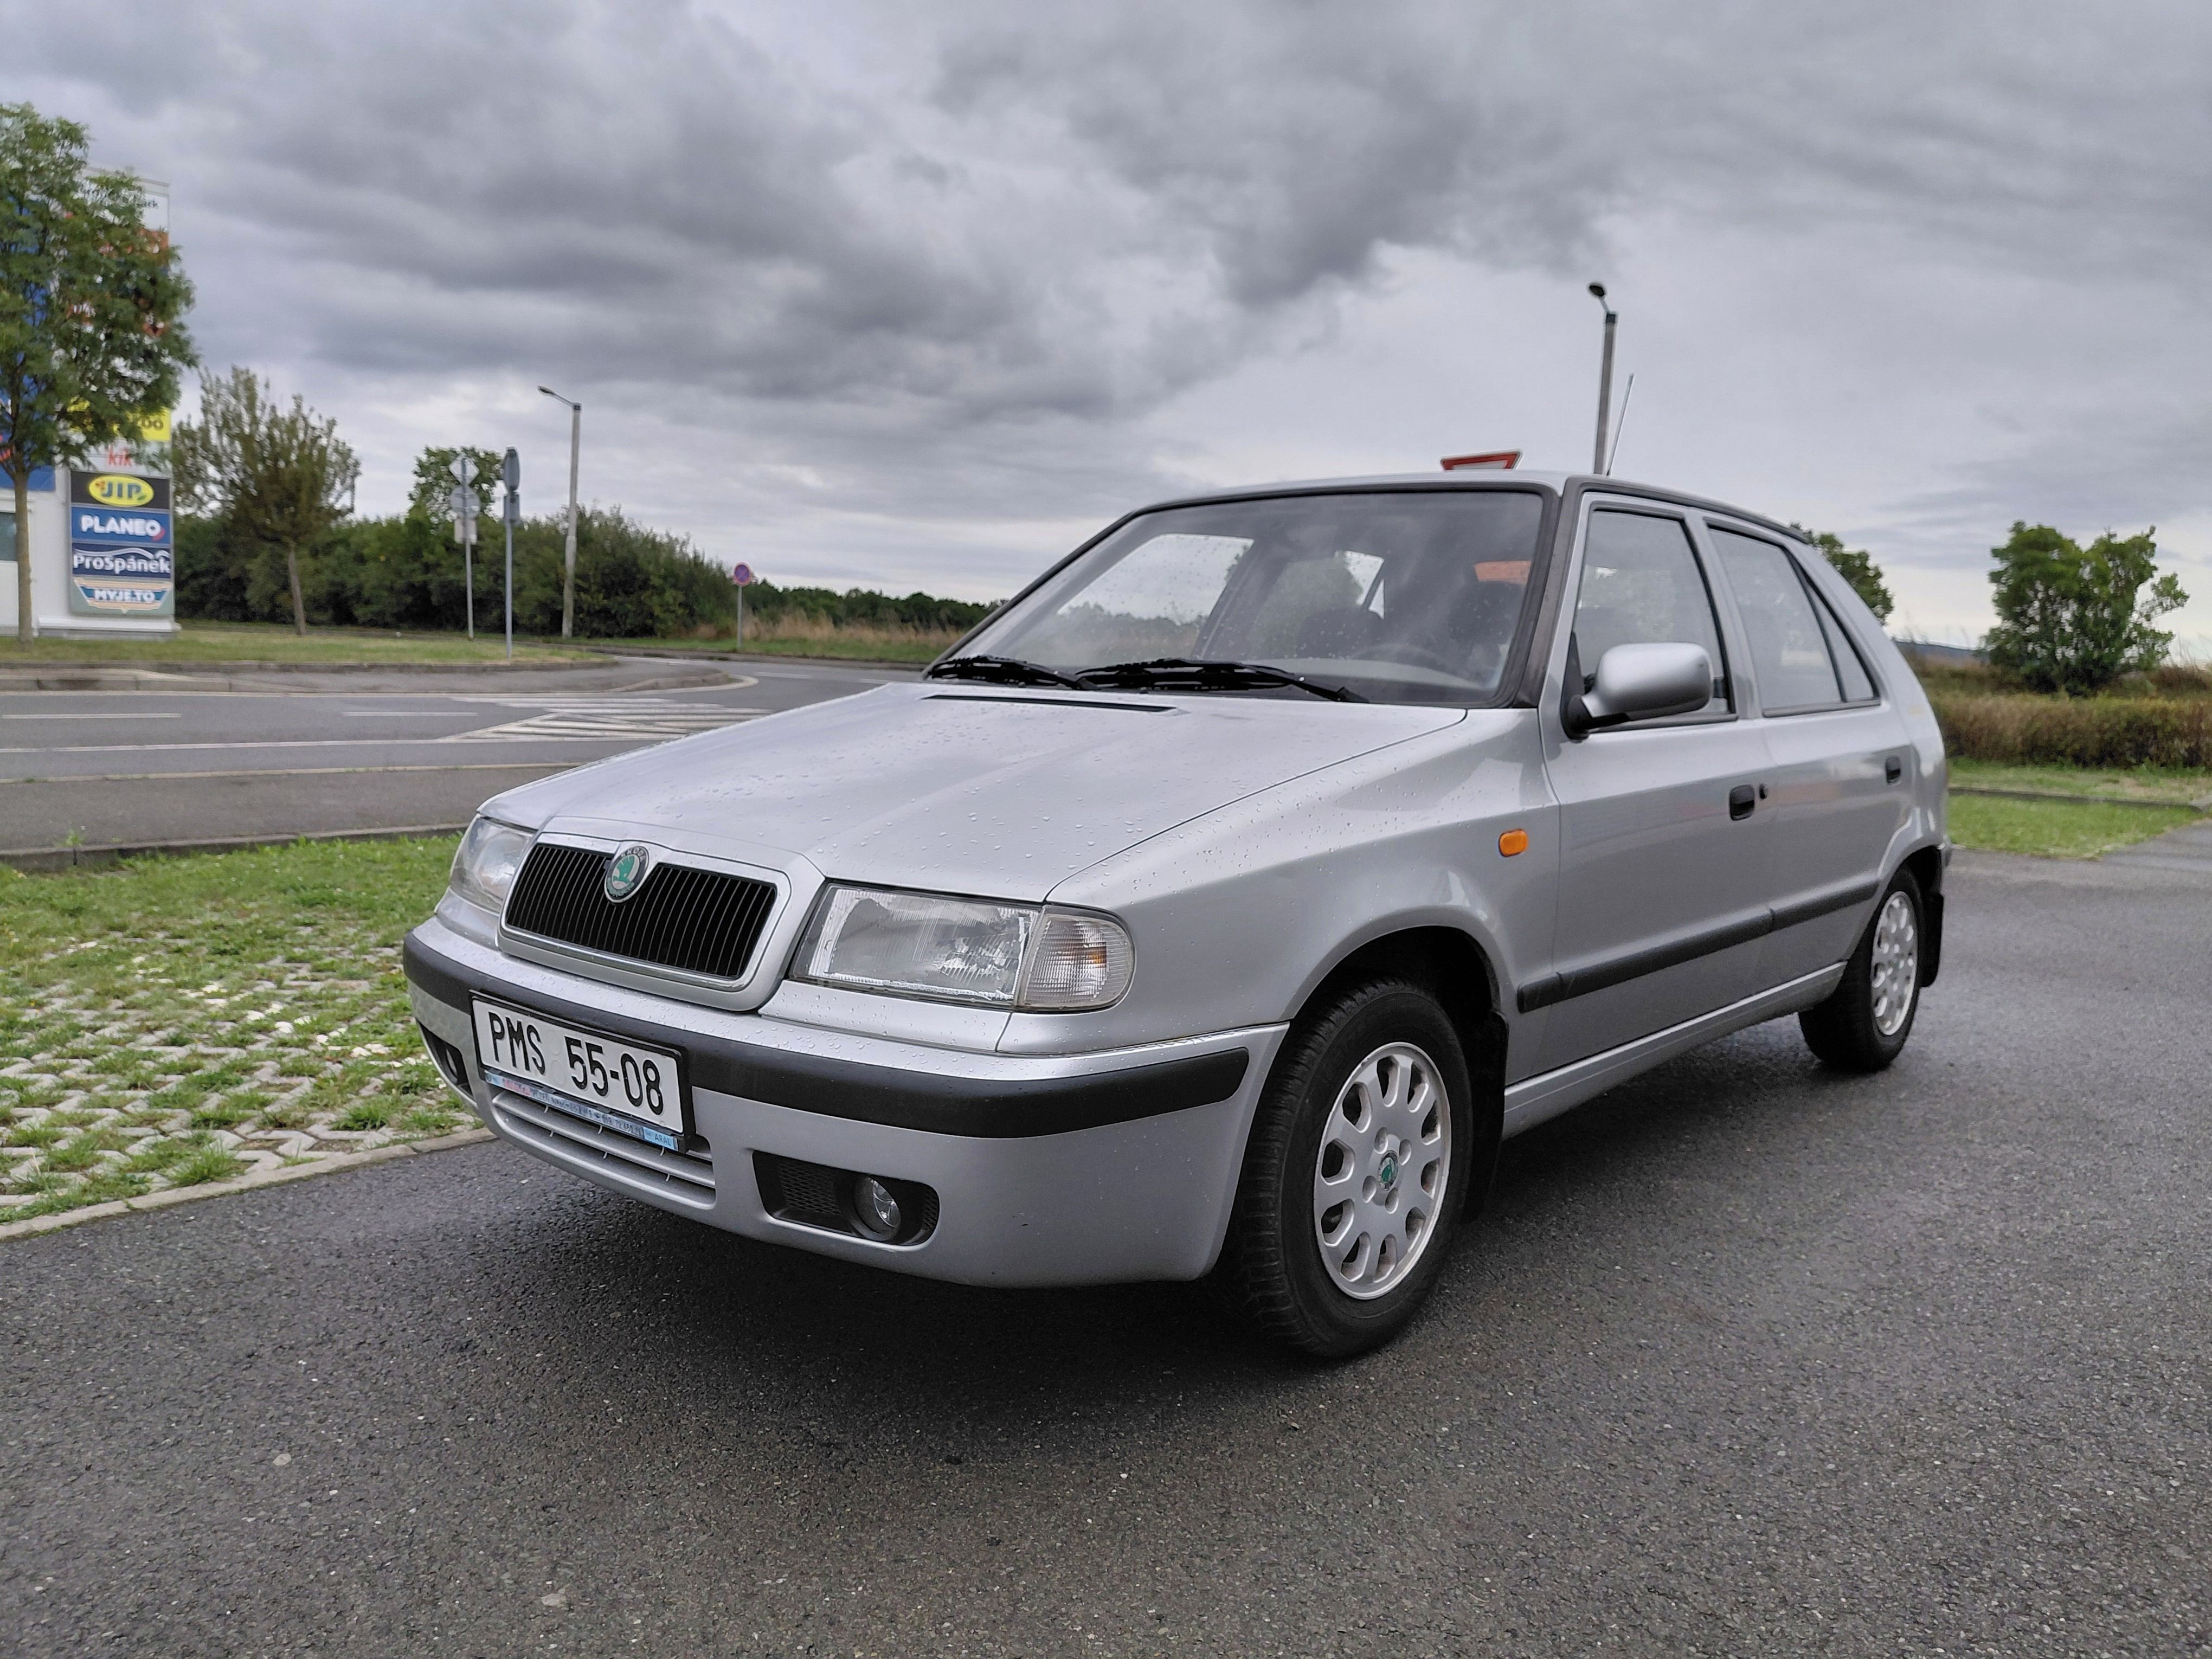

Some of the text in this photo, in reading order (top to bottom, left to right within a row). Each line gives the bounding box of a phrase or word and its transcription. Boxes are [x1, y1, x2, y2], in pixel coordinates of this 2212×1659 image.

[102, 481, 142, 499] JIP
[81, 515, 162, 537] PLANEO
[488, 1012, 545, 1075] PMS
[564, 1036, 664, 1115] 55-08
[654, 1133, 672, 1146] ARAL
